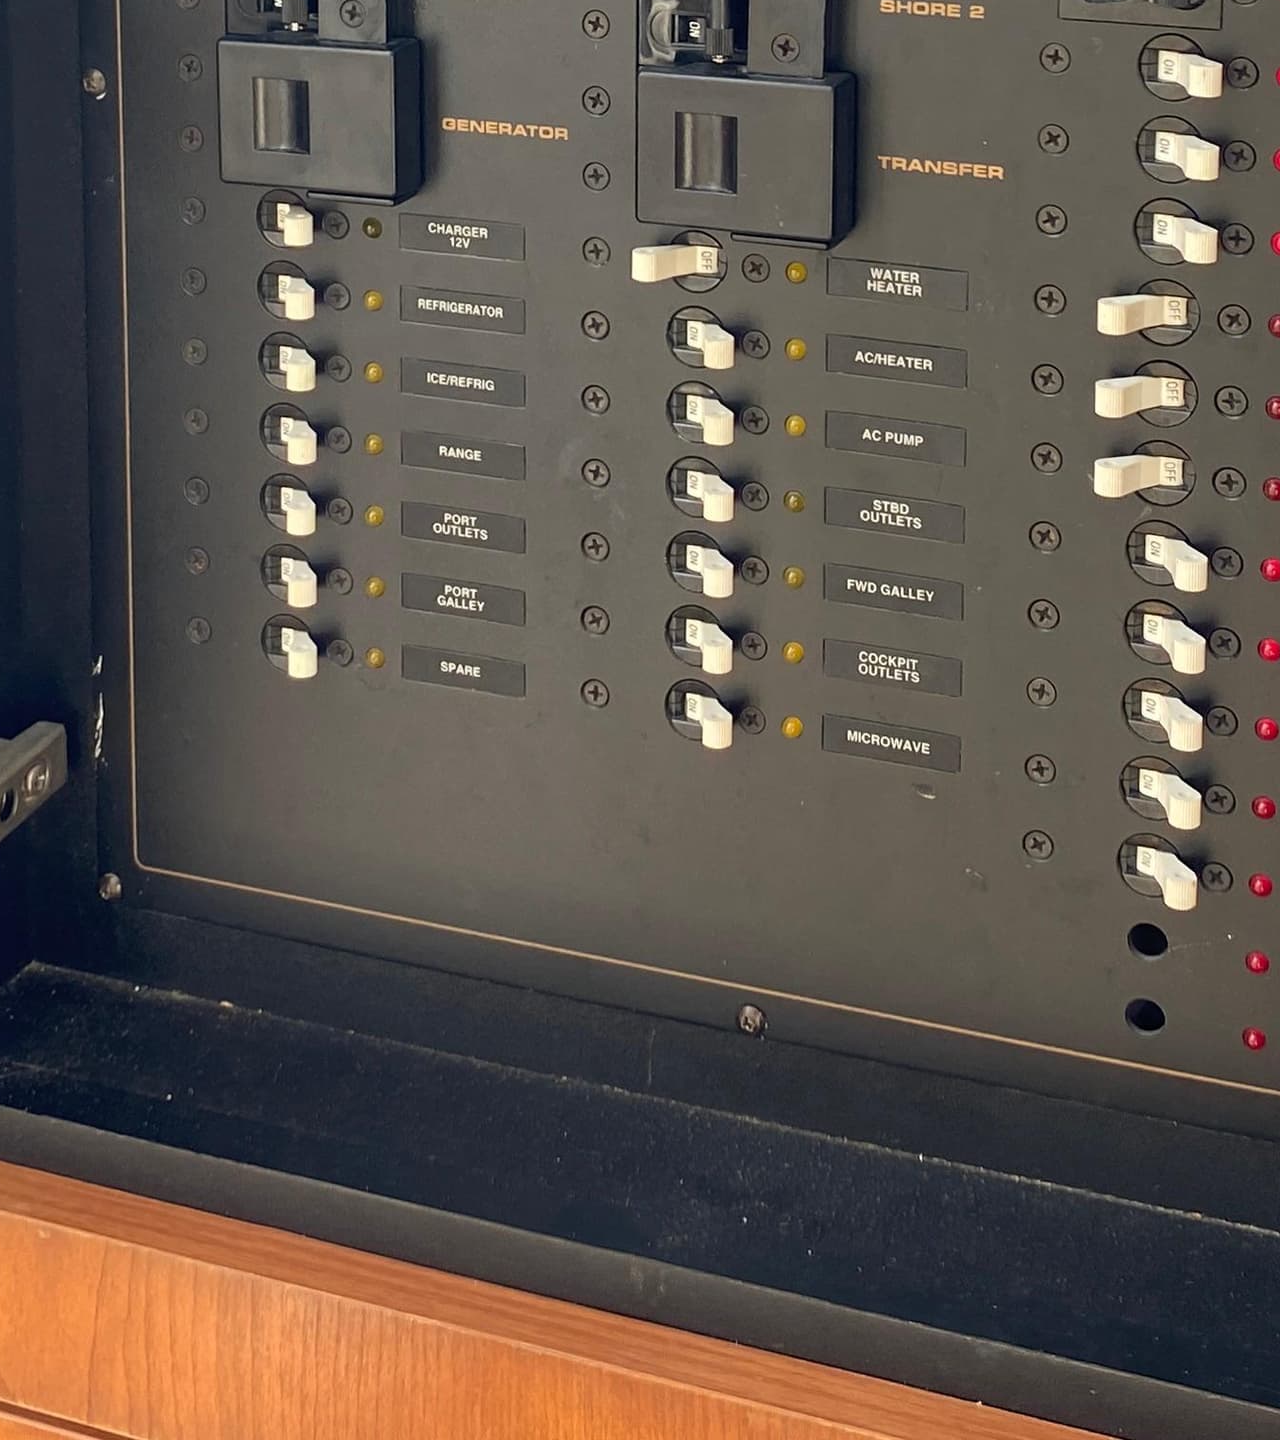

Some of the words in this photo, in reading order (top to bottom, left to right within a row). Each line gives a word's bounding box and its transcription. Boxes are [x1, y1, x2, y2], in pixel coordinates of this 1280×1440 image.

[880, 0, 961, 17] SHORE
[970, 6, 984, 18] 2
[443, 118, 568, 140] GENERATOR
[878, 156, 1003, 179] TRANSFER
[428, 223, 488, 238] CHARGER
[450, 237, 470, 248] 12V
[871, 268, 919, 283] WATER
[867, 280, 921, 297] HEATER
[418, 299, 503, 318] REFRIGERATOR
[855, 351, 932, 371] AC/HEATER
[427, 373, 494, 390] ICE/REFRIG
[863, 429, 881, 441] AC
[886, 432, 923, 446] PUMP
[440, 446, 481, 461] RANGE
[873, 500, 909, 514] STBD
[445, 513, 477, 526] PORT
[860, 510, 921, 529] OUTLETS
[433, 523, 488, 540] OUTLETS
[445, 585, 477, 599] PORT
[848, 579, 876, 593] FWD
[881, 584, 934, 601] GALLEY
[437, 595, 484, 611] GALLEY
[441, 661, 480, 677] SPARE
[859, 651, 918, 670] COCKPIT
[859, 664, 919, 682] OUTLETS
[848, 730, 929, 754] MICROWAVE
